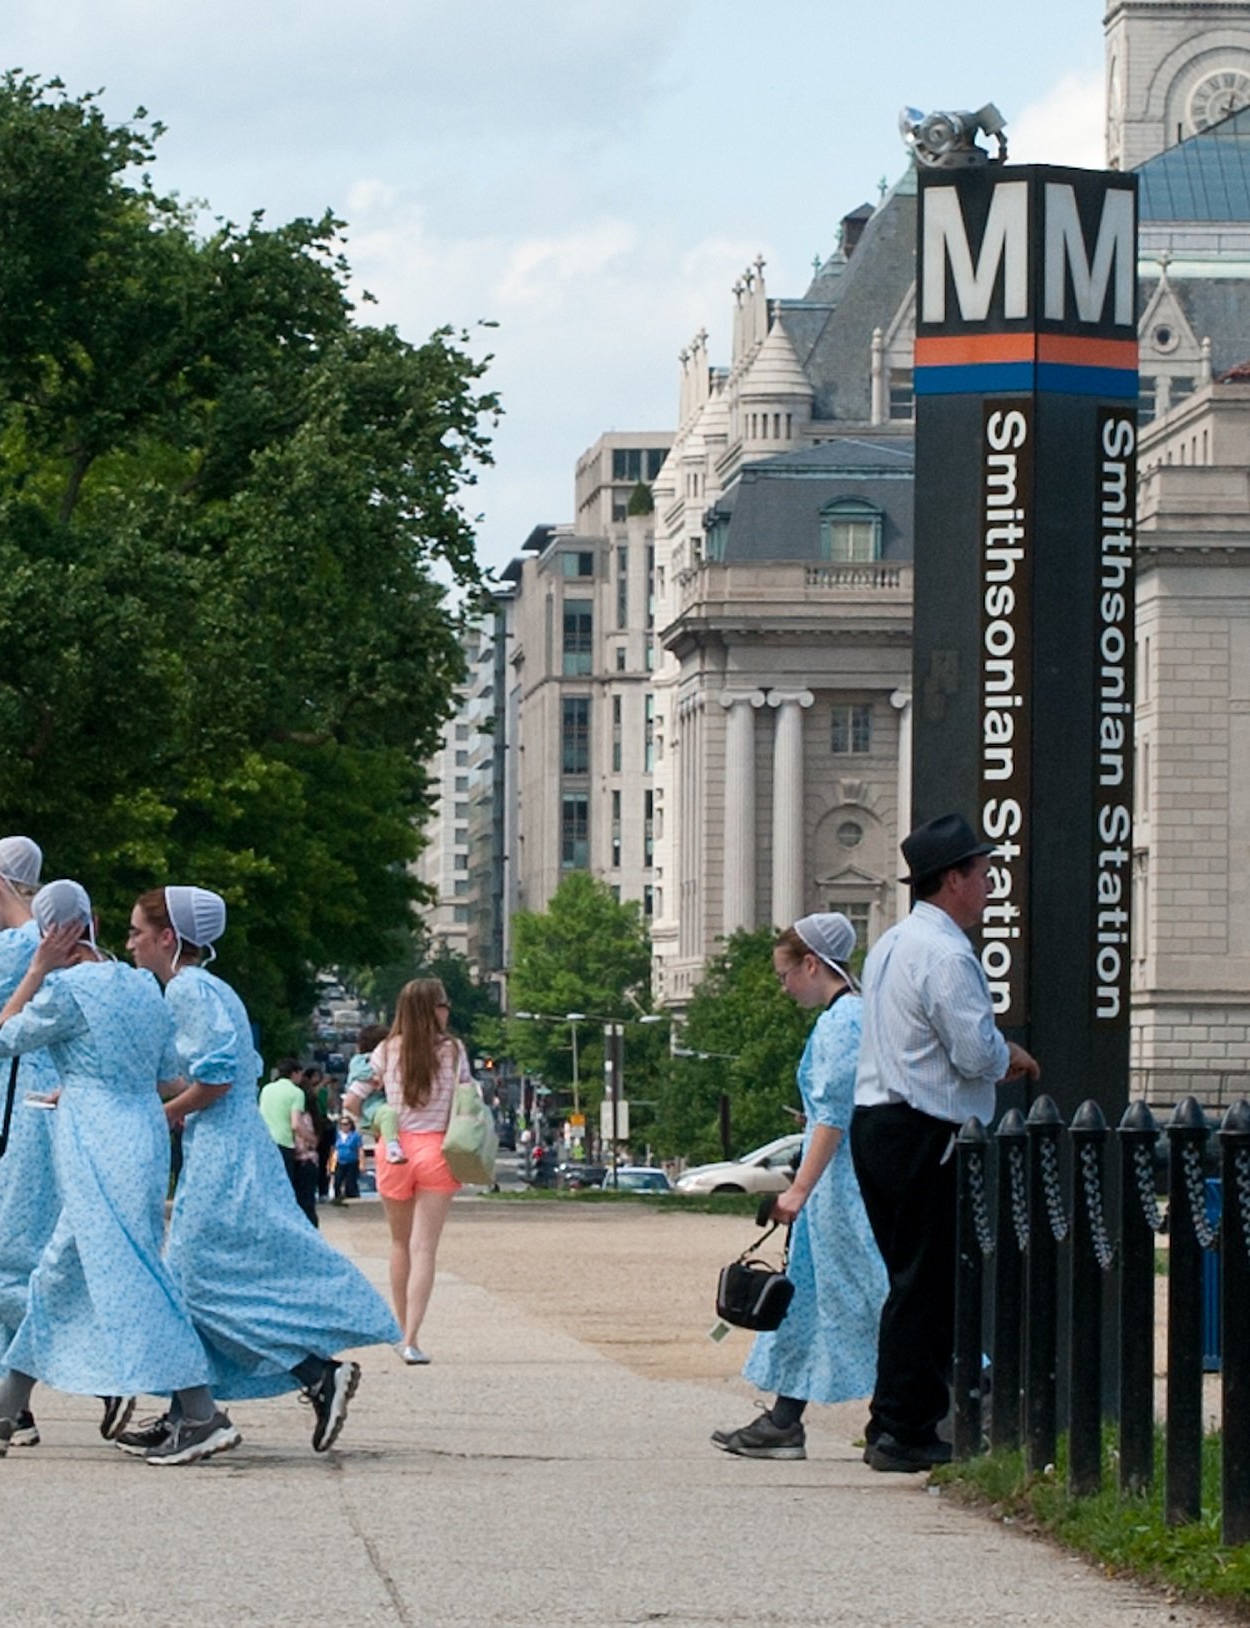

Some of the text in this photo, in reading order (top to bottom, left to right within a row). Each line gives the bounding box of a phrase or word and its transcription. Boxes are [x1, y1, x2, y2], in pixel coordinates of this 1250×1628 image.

[923, 181, 1028, 323] M
[1044, 183, 1134, 325] M
[981, 411, 1027, 1015] Smithsonian Station
[1096, 418, 1134, 1018] Smithsonian Station
